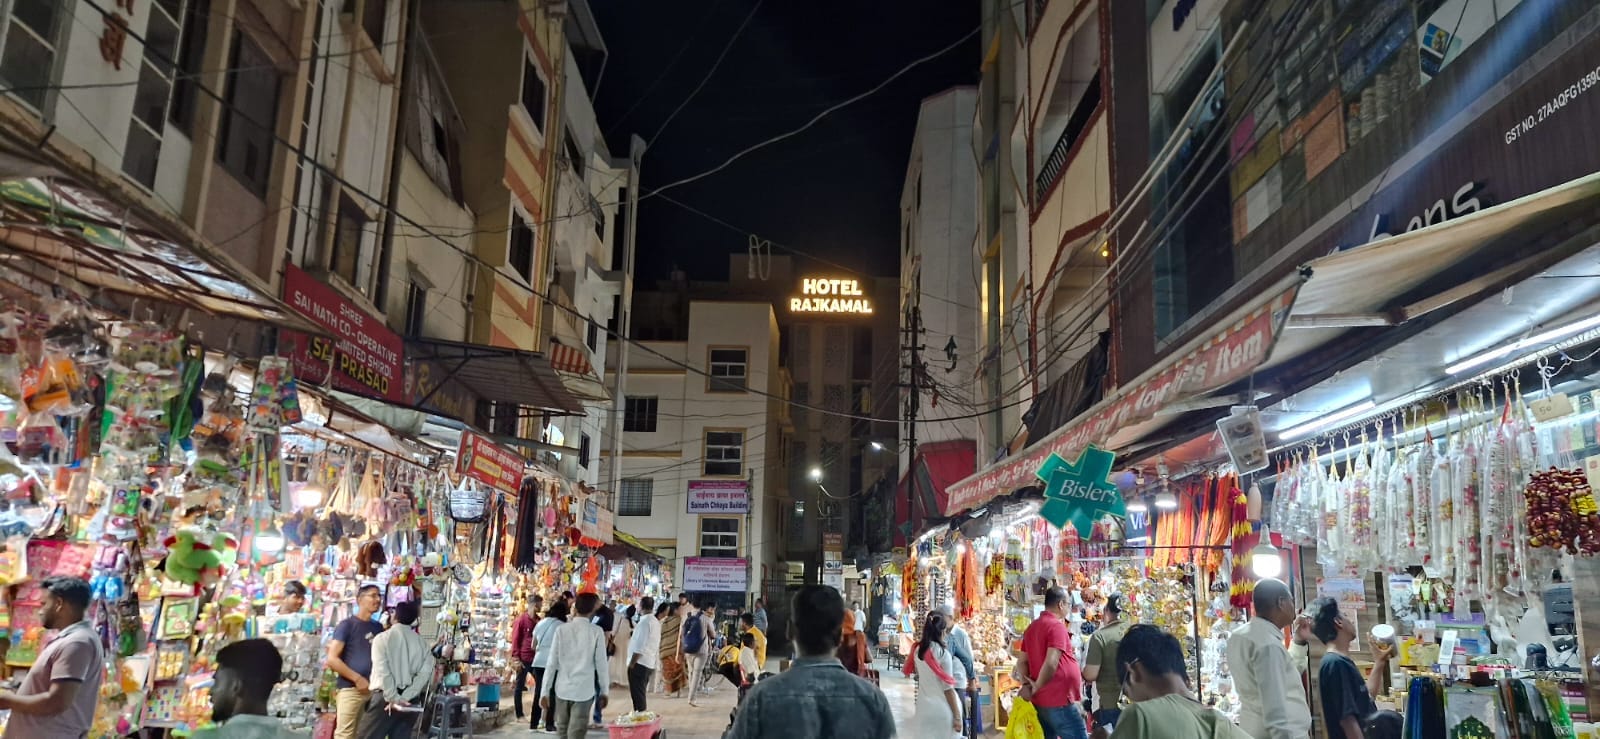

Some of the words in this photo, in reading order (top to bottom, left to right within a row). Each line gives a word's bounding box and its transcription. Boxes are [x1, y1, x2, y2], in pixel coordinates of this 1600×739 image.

[1505, 123, 1521, 145] GST
[1522, 114, 1537, 134] NO.
[802, 278, 862, 296] HOTEL
[293, 290, 311, 311] SAI
[313, 302, 338, 328] NATH
[339, 303, 364, 327] SHREE
[790, 297, 873, 313] RAJKAMAL
[1214, 330, 1263, 378] Item
[340, 354, 389, 395] PRASAD
